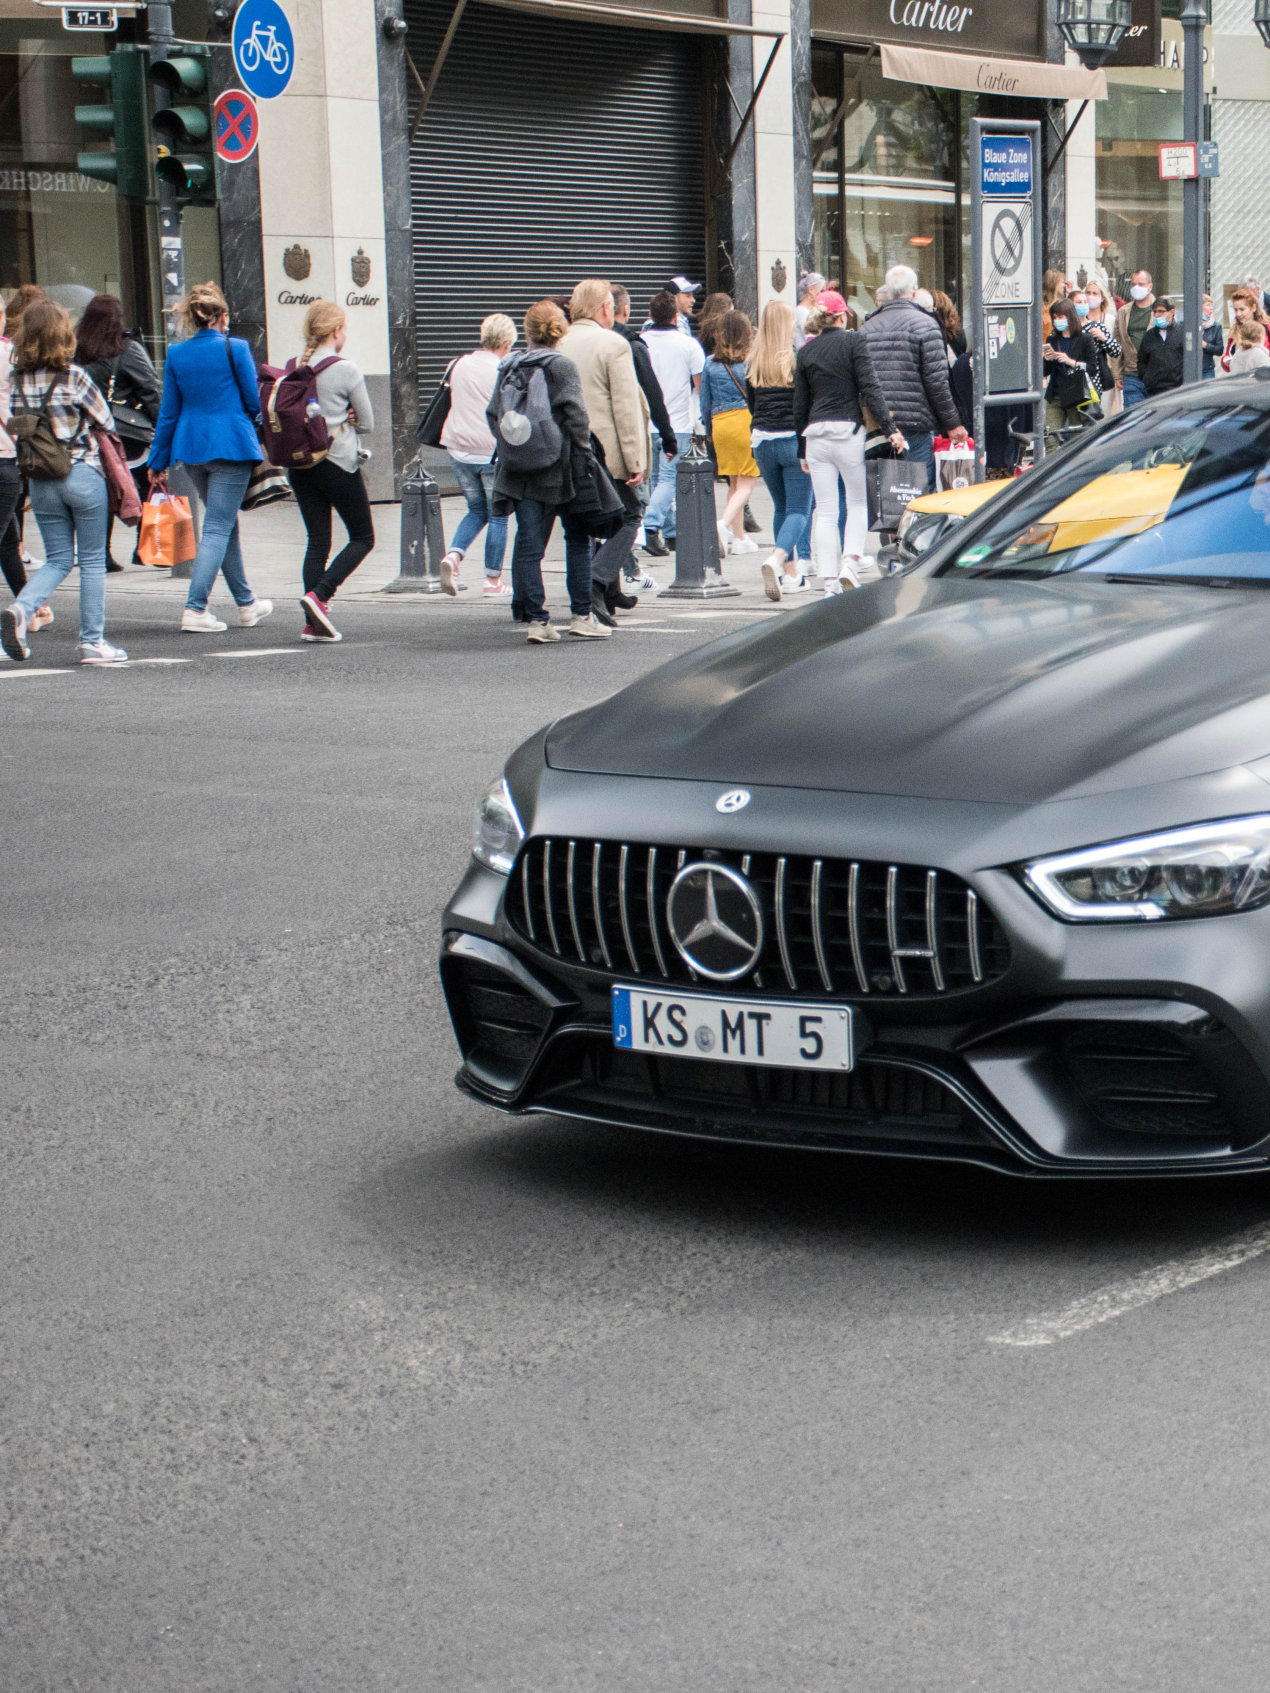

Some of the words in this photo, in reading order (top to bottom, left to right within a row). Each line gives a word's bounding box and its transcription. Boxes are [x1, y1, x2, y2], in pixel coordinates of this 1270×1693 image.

[77, 12, 102, 25] 17-1
[889, 0, 973, 32] Cartier
[1125, 25, 1148, 37] er
[976, 62, 1020, 92] Cartier
[984, 148, 1007, 163] Blaue
[1008, 148, 1028, 163] Zone
[983, 167, 1030, 186] Königsallee
[994, 282, 1021, 299] ZONE
[346, 292, 380, 307] Cartier
[618, 1024, 627, 1039] D
[641, 999, 690, 1049] KS
[720, 1008, 772, 1058] MT
[798, 1014, 824, 1061] 5
